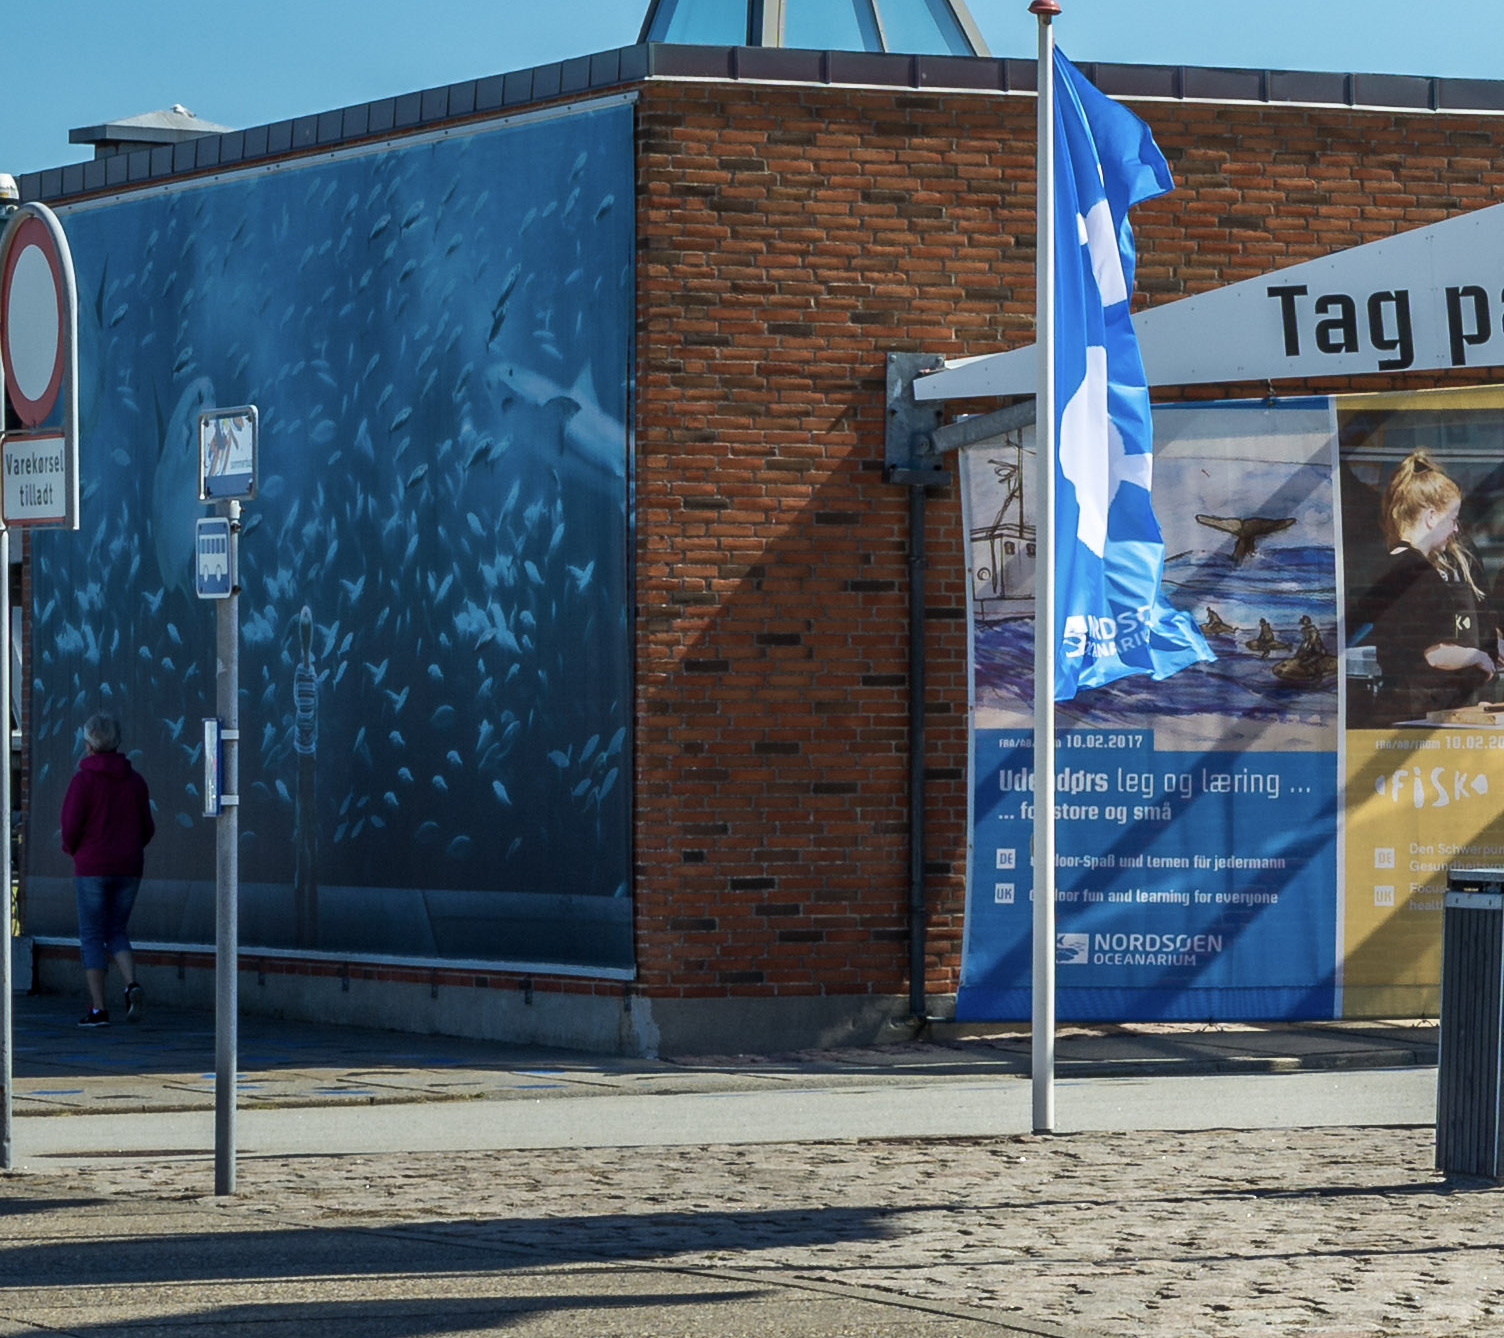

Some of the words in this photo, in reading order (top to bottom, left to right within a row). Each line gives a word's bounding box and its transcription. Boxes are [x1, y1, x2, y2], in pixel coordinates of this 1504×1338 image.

[1267, 285, 1414, 371] Tag
[5, 449, 65, 476] Varekørsel
[19, 483, 54, 507] tilladt
[1065, 734, 1143, 749] 10.02.2017
[1116, 767, 1154, 799] leg
[1163, 772, 1193, 800] og
[1202, 767, 1281, 799] læring
[1053, 802, 1099, 821] store
[1104, 805, 1128, 825] og
[1133, 801, 1173, 821] små
[998, 851, 1014, 866] DE
[1119, 854, 1144, 869] und
[1146, 854, 1190, 870] Lernen
[1192, 853, 1212, 869] für
[1213, 854, 1287, 872] jedermann
[1378, 852, 1393, 864] DE
[1409, 842, 1435, 855] Den
[995, 887, 1013, 901] UK
[1082, 888, 1105, 903] fun
[1108, 888, 1133, 903] and
[1135, 888, 1190, 907] learning
[1194, 888, 1213, 903] for
[1215, 890, 1279, 907] everyone
[1375, 890, 1393, 903] UK
[1094, 933, 1223, 953] NORDSØEN
[1093, 952, 1197, 967] OCEANARIUM
